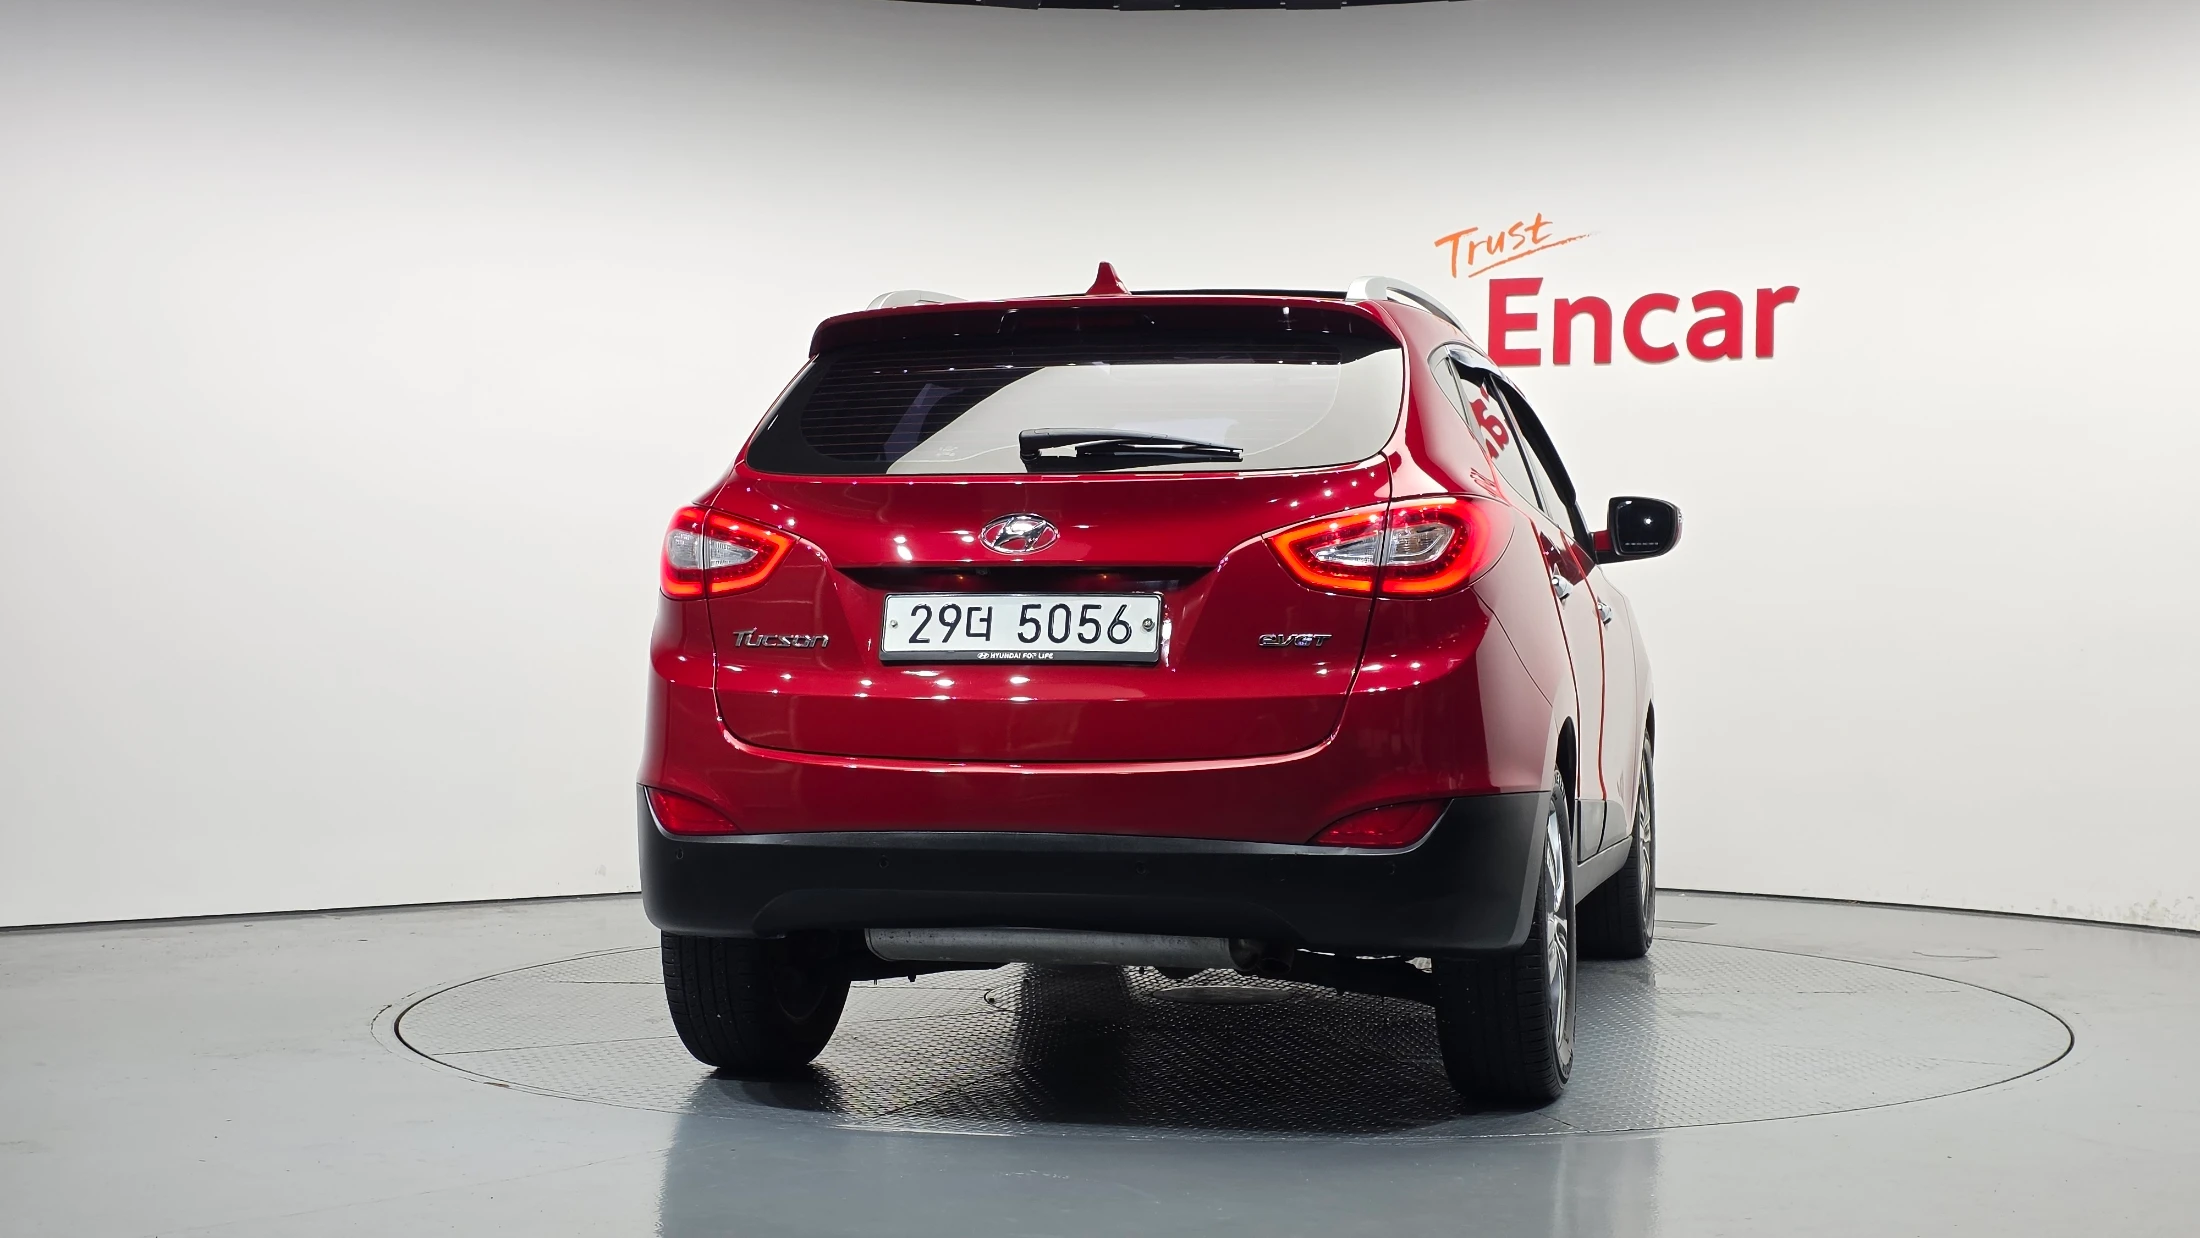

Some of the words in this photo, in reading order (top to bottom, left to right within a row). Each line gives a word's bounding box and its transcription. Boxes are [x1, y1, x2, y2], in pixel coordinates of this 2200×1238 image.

[1434, 212, 1553, 278] Trust
[1487, 277, 1800, 367] Encar
[733, 627, 829, 648] Tucson
[909, 602, 994, 645] 29더
[1017, 603, 1133, 645] 5056
